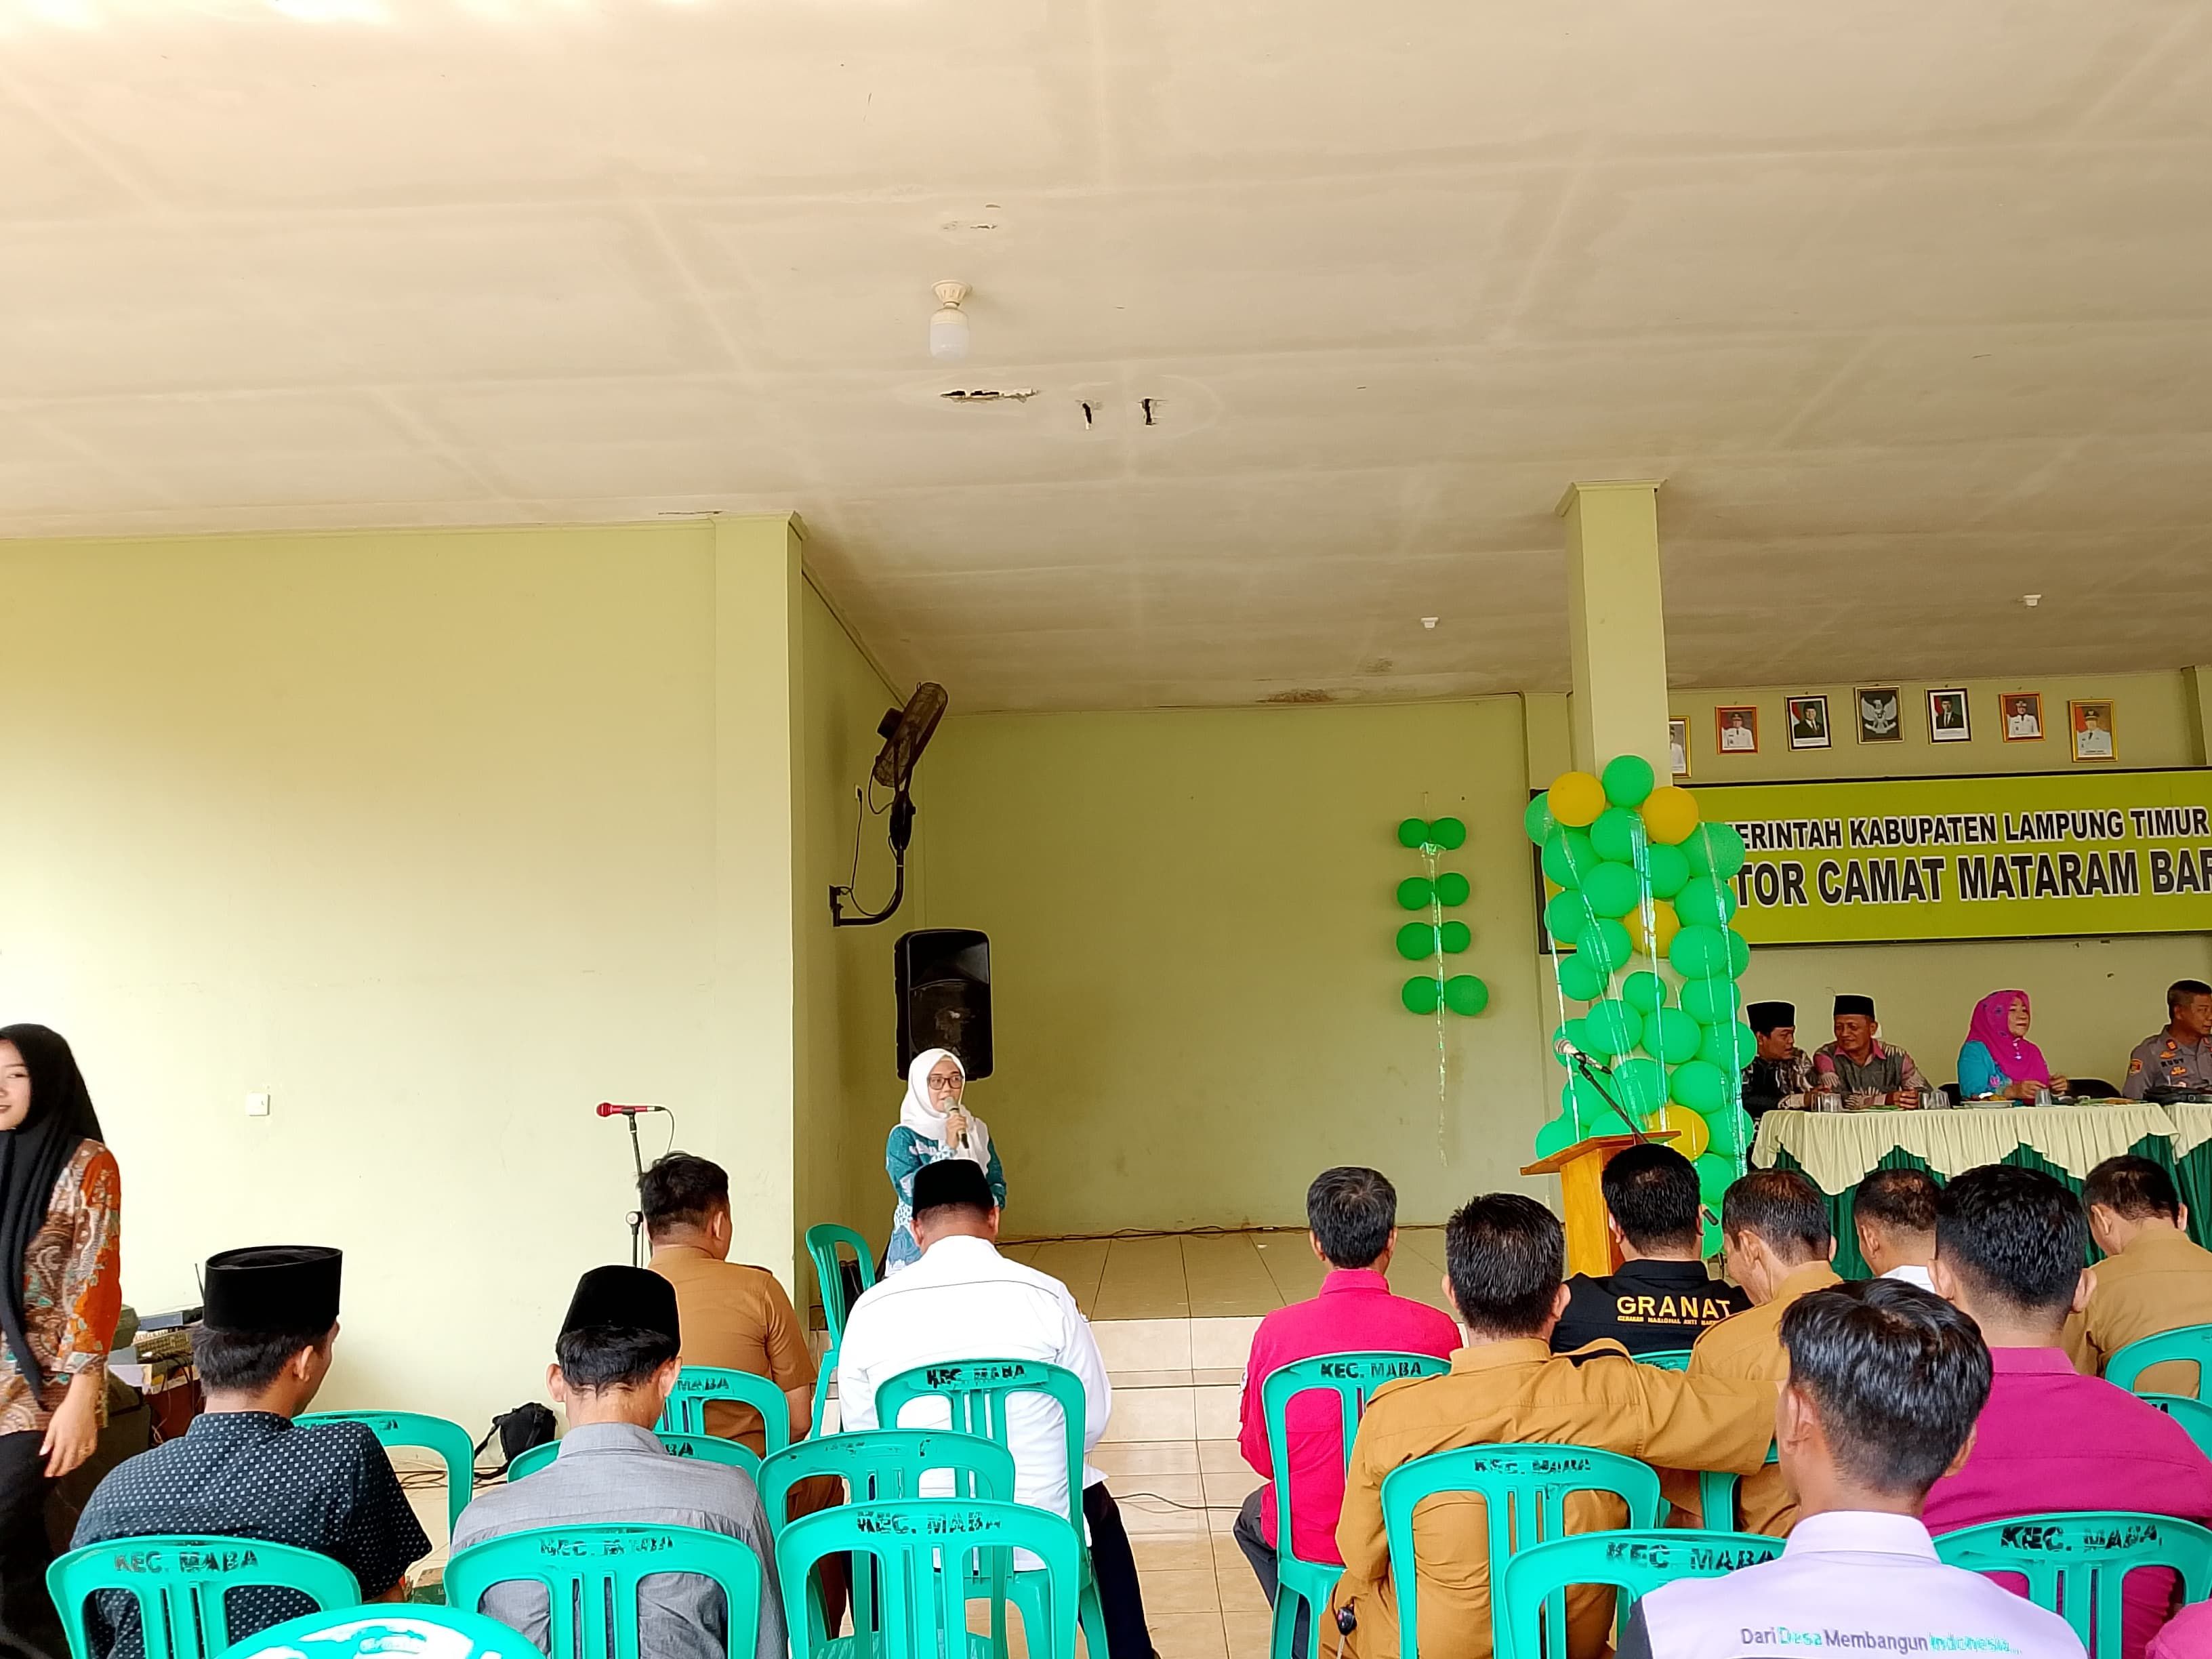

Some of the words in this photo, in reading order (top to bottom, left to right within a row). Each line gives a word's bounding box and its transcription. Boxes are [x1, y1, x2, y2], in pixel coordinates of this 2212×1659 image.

[1730, 819, 1843, 849] ERINTAH
[1850, 815, 1997, 846] KABUPATEN
[2004, 811, 2125, 842] LAMPUNG
[2130, 808, 2209, 838] TIMUR
[1736, 861, 1808, 907] TOR
[1818, 857, 1945, 905] CAMAT
[1957, 851, 2140, 901] MATARAM
[1616, 1295, 1731, 1319] GRANAT
[1320, 1362, 1365, 1378] KEC.
[1370, 1361, 1422, 1378] MABA
[2001, 1525, 2072, 1552] KEC.
[1741, 1627, 1776, 1645] Dari
[1778, 1627, 1822, 1645] Desa
[1824, 1629, 1929, 1654] Membangun
